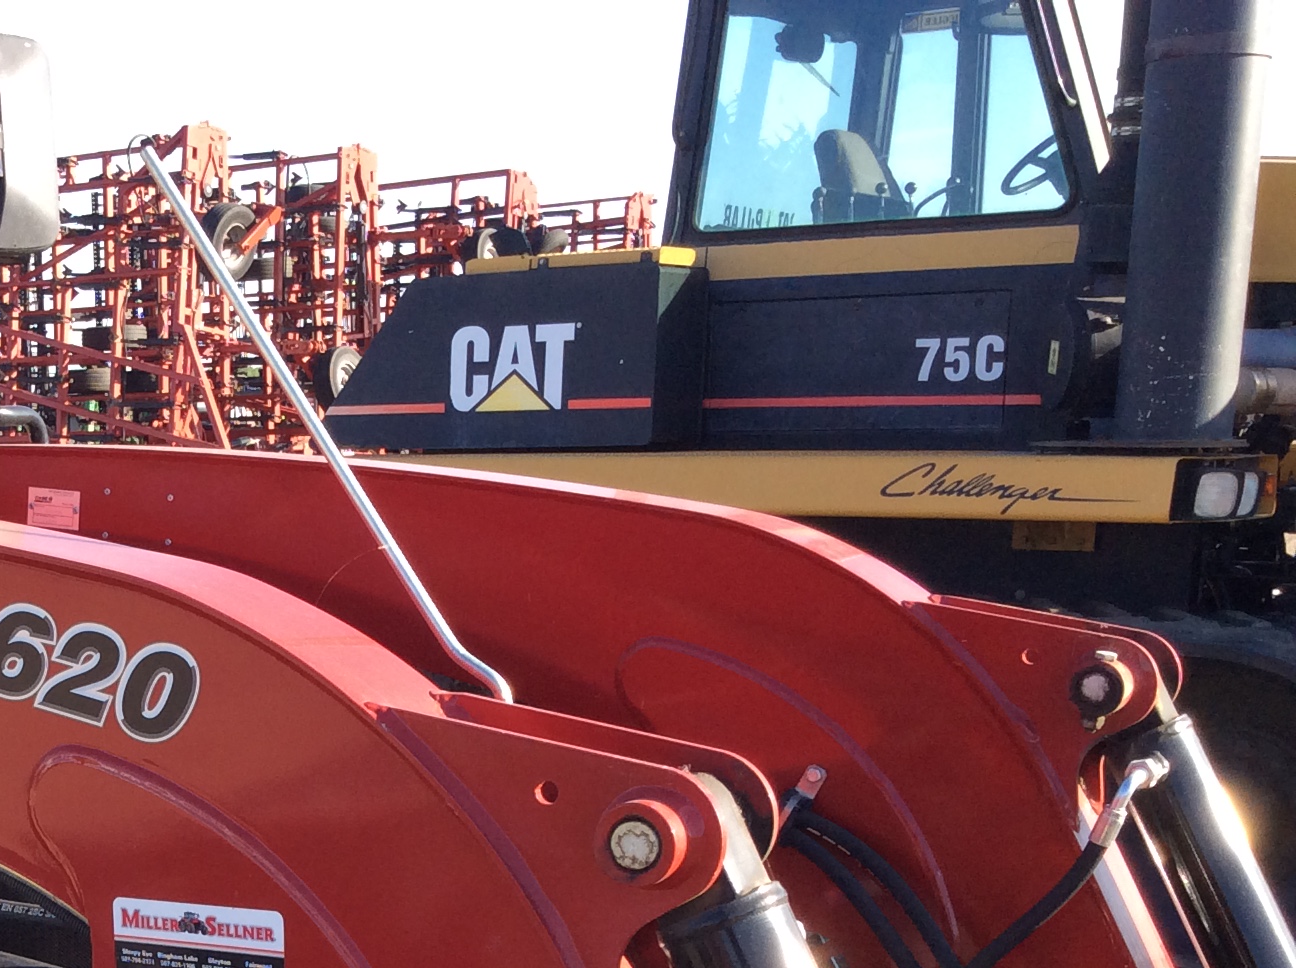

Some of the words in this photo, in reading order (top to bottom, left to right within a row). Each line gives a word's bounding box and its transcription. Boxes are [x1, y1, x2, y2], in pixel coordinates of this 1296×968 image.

[450, 322, 576, 412] CAT
[915, 335, 1005, 382] 75C
[880, 462, 1142, 515] Challenger
[120, 908, 179, 933] MILLER
[205, 915, 277, 942] SELLNER
